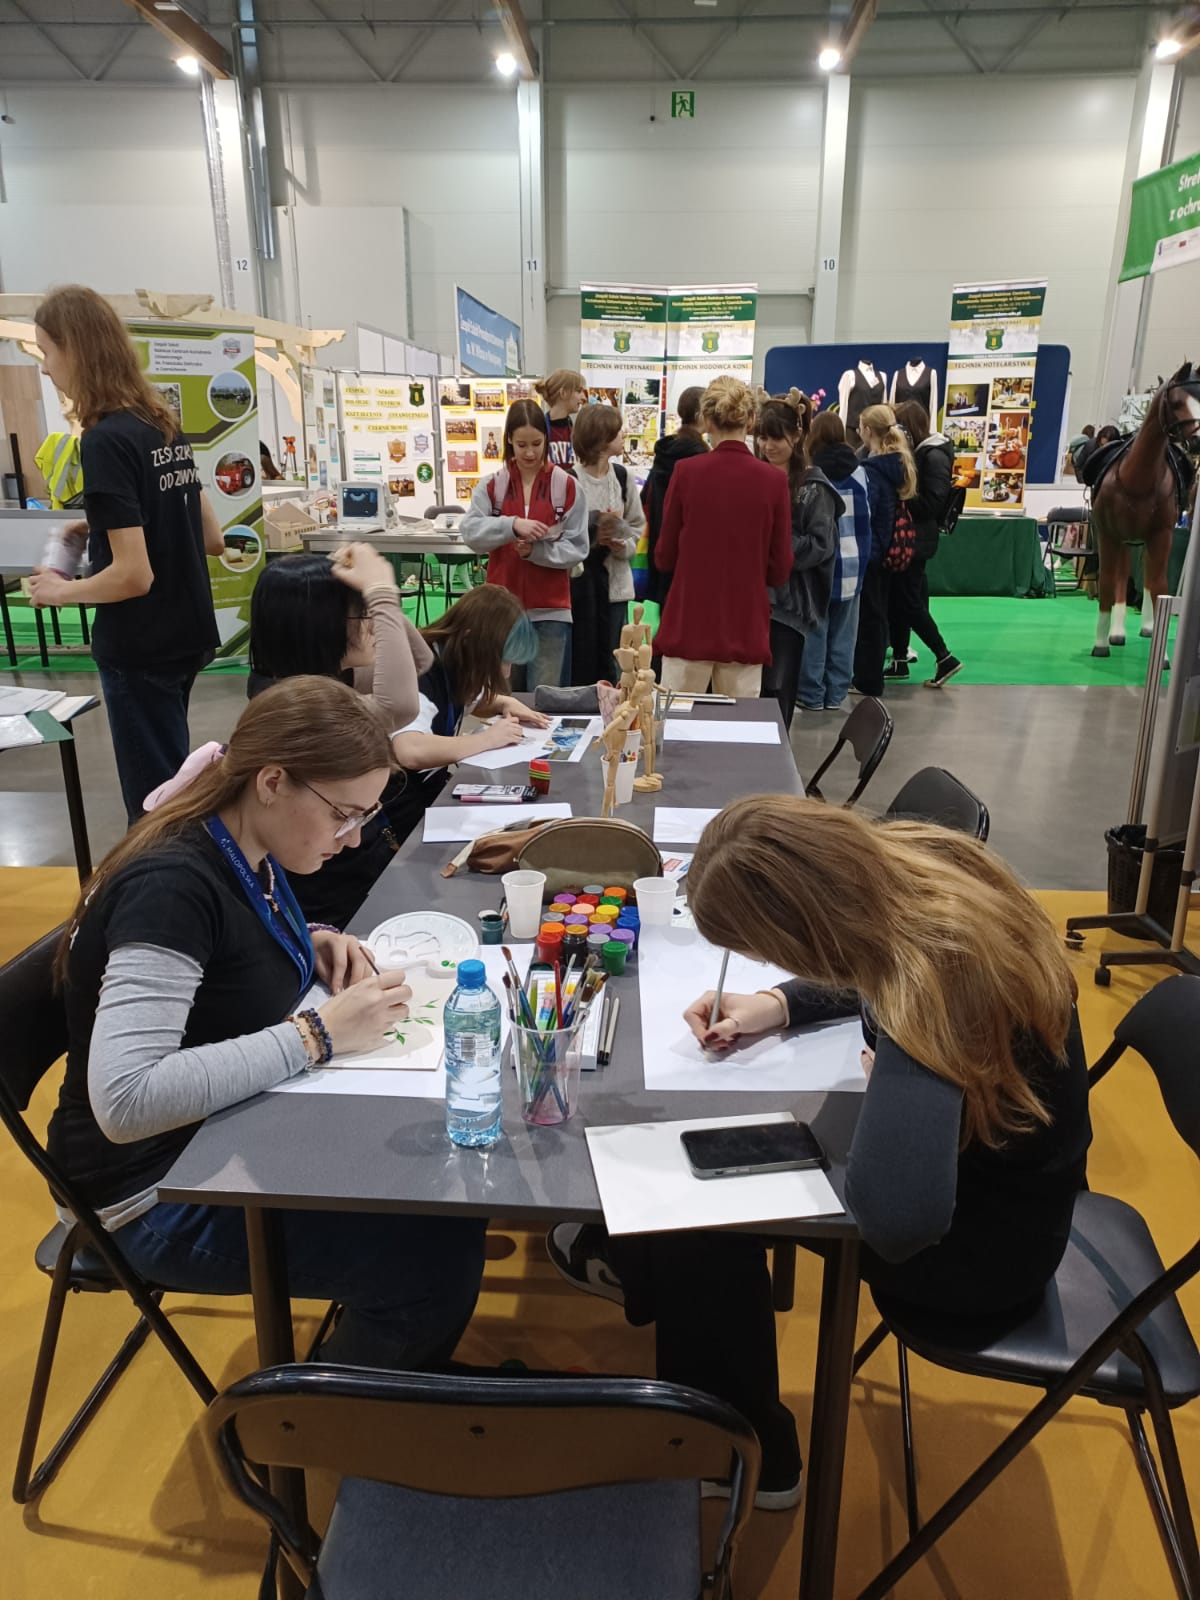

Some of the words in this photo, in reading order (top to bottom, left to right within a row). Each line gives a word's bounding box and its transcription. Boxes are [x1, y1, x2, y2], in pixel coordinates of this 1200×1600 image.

[1178, 168, 1200, 192] Stre
[236, 259, 248, 271] 12
[526, 260, 537, 271] 11
[824, 259, 835, 271] 10
[983, 360, 1031, 368] HOTELARSTWA
[548, 441, 580, 464] RVA
